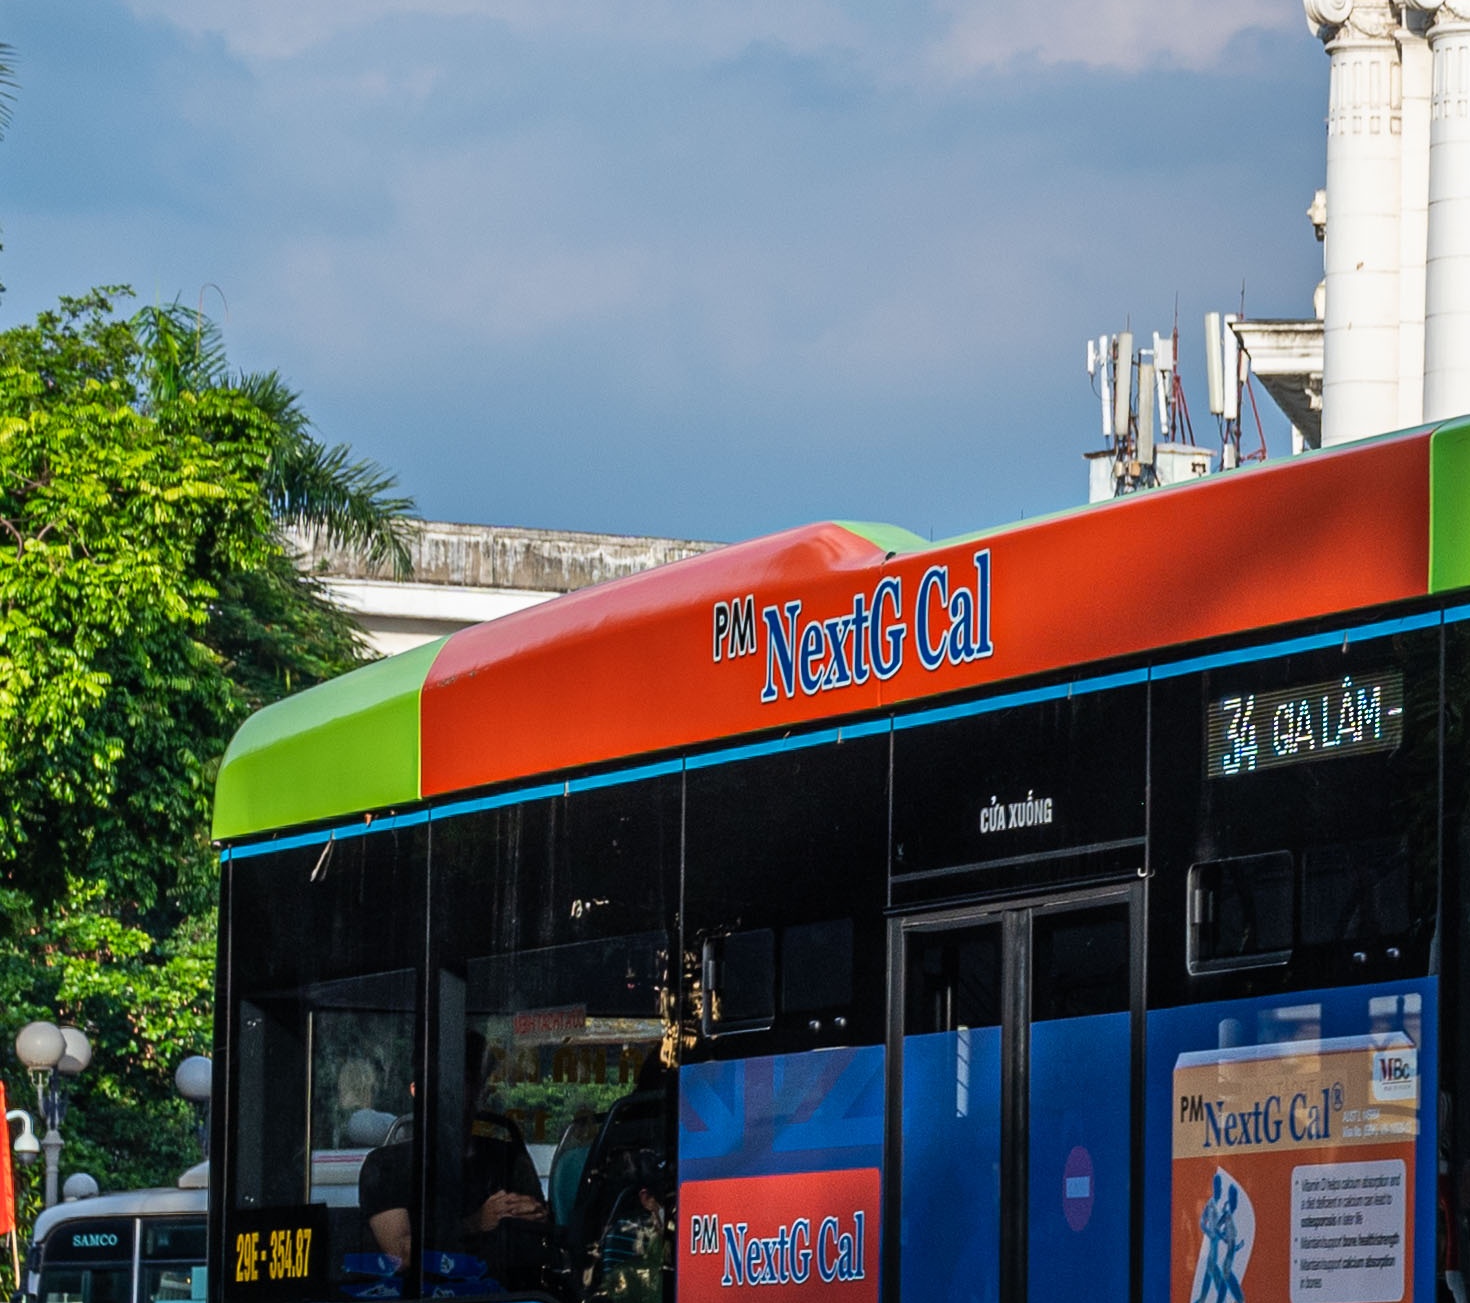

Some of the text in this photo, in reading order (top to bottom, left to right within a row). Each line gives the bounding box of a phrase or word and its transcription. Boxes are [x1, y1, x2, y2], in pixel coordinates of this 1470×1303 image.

[713, 548, 994, 704] PM NextG Cal
[1222, 695, 1259, 776] 34
[979, 790, 1054, 834] CỬA XUỐNG
[1180, 1094, 1204, 1124] PM
[1203, 1094, 1284, 1149] NextG
[73, 1233, 118, 1246] SAMCO
[235, 1230, 259, 1283] 29E
[269, 1228, 312, 1281] 354.87
[690, 1210, 865, 1288] PM NextG Cal
